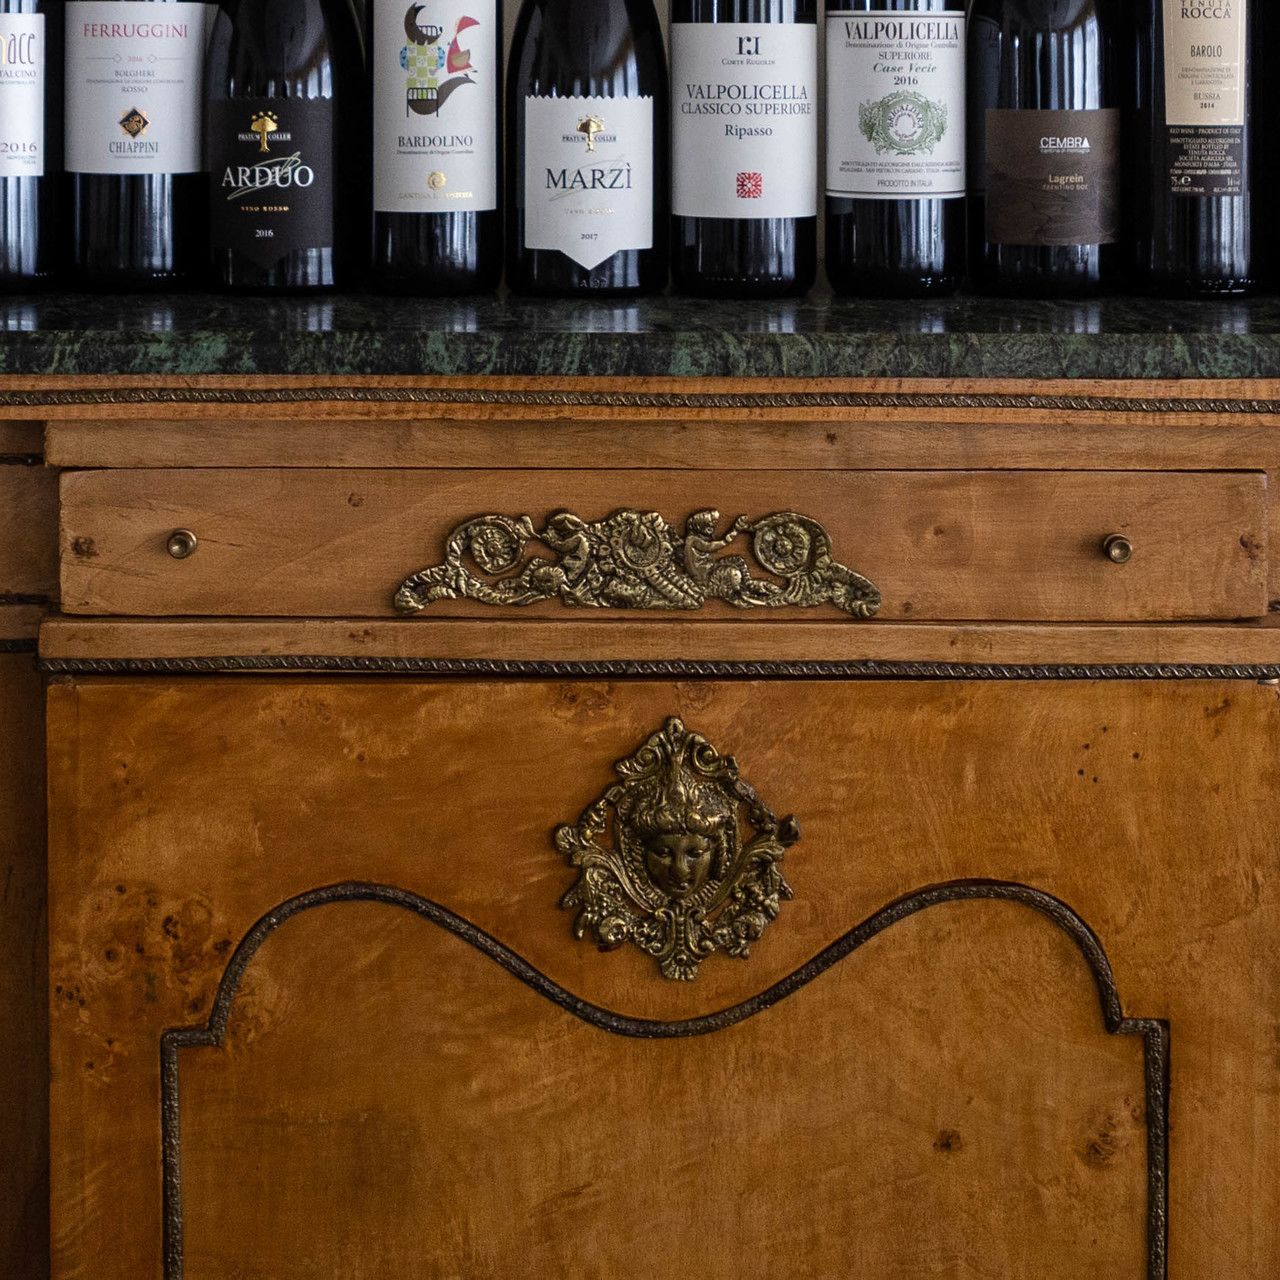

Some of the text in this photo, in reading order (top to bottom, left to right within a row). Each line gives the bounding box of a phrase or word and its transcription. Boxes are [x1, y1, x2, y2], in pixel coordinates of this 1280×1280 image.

[1181, 8, 1231, 19] ROCCA
[83, 23, 188, 38] FERRUGGINI
[845, 22, 959, 40] VALPOLICELLA
[878, 52, 932, 60] SUPERIORE
[1190, 45, 1223, 58] BAROLO
[873, 63, 904, 73] Case
[893, 76, 919, 86] 2016
[686, 84, 808, 100] VALPOLICELLA
[681, 102, 812, 115] CLASSICO SUPERIORE
[724, 124, 773, 139] Ripasso
[0, 142, 37, 152] 2016
[109, 141, 158, 153] CHIAPPINI
[398, 135, 473, 147] BARDOLINO
[1040, 136, 1090, 148] CEMBRA
[222, 166, 314, 187] ARDUO
[545, 162, 632, 189] MARZÌ
[1049, 174, 1084, 185] Lagrein
[255, 229, 274, 237] 2016
